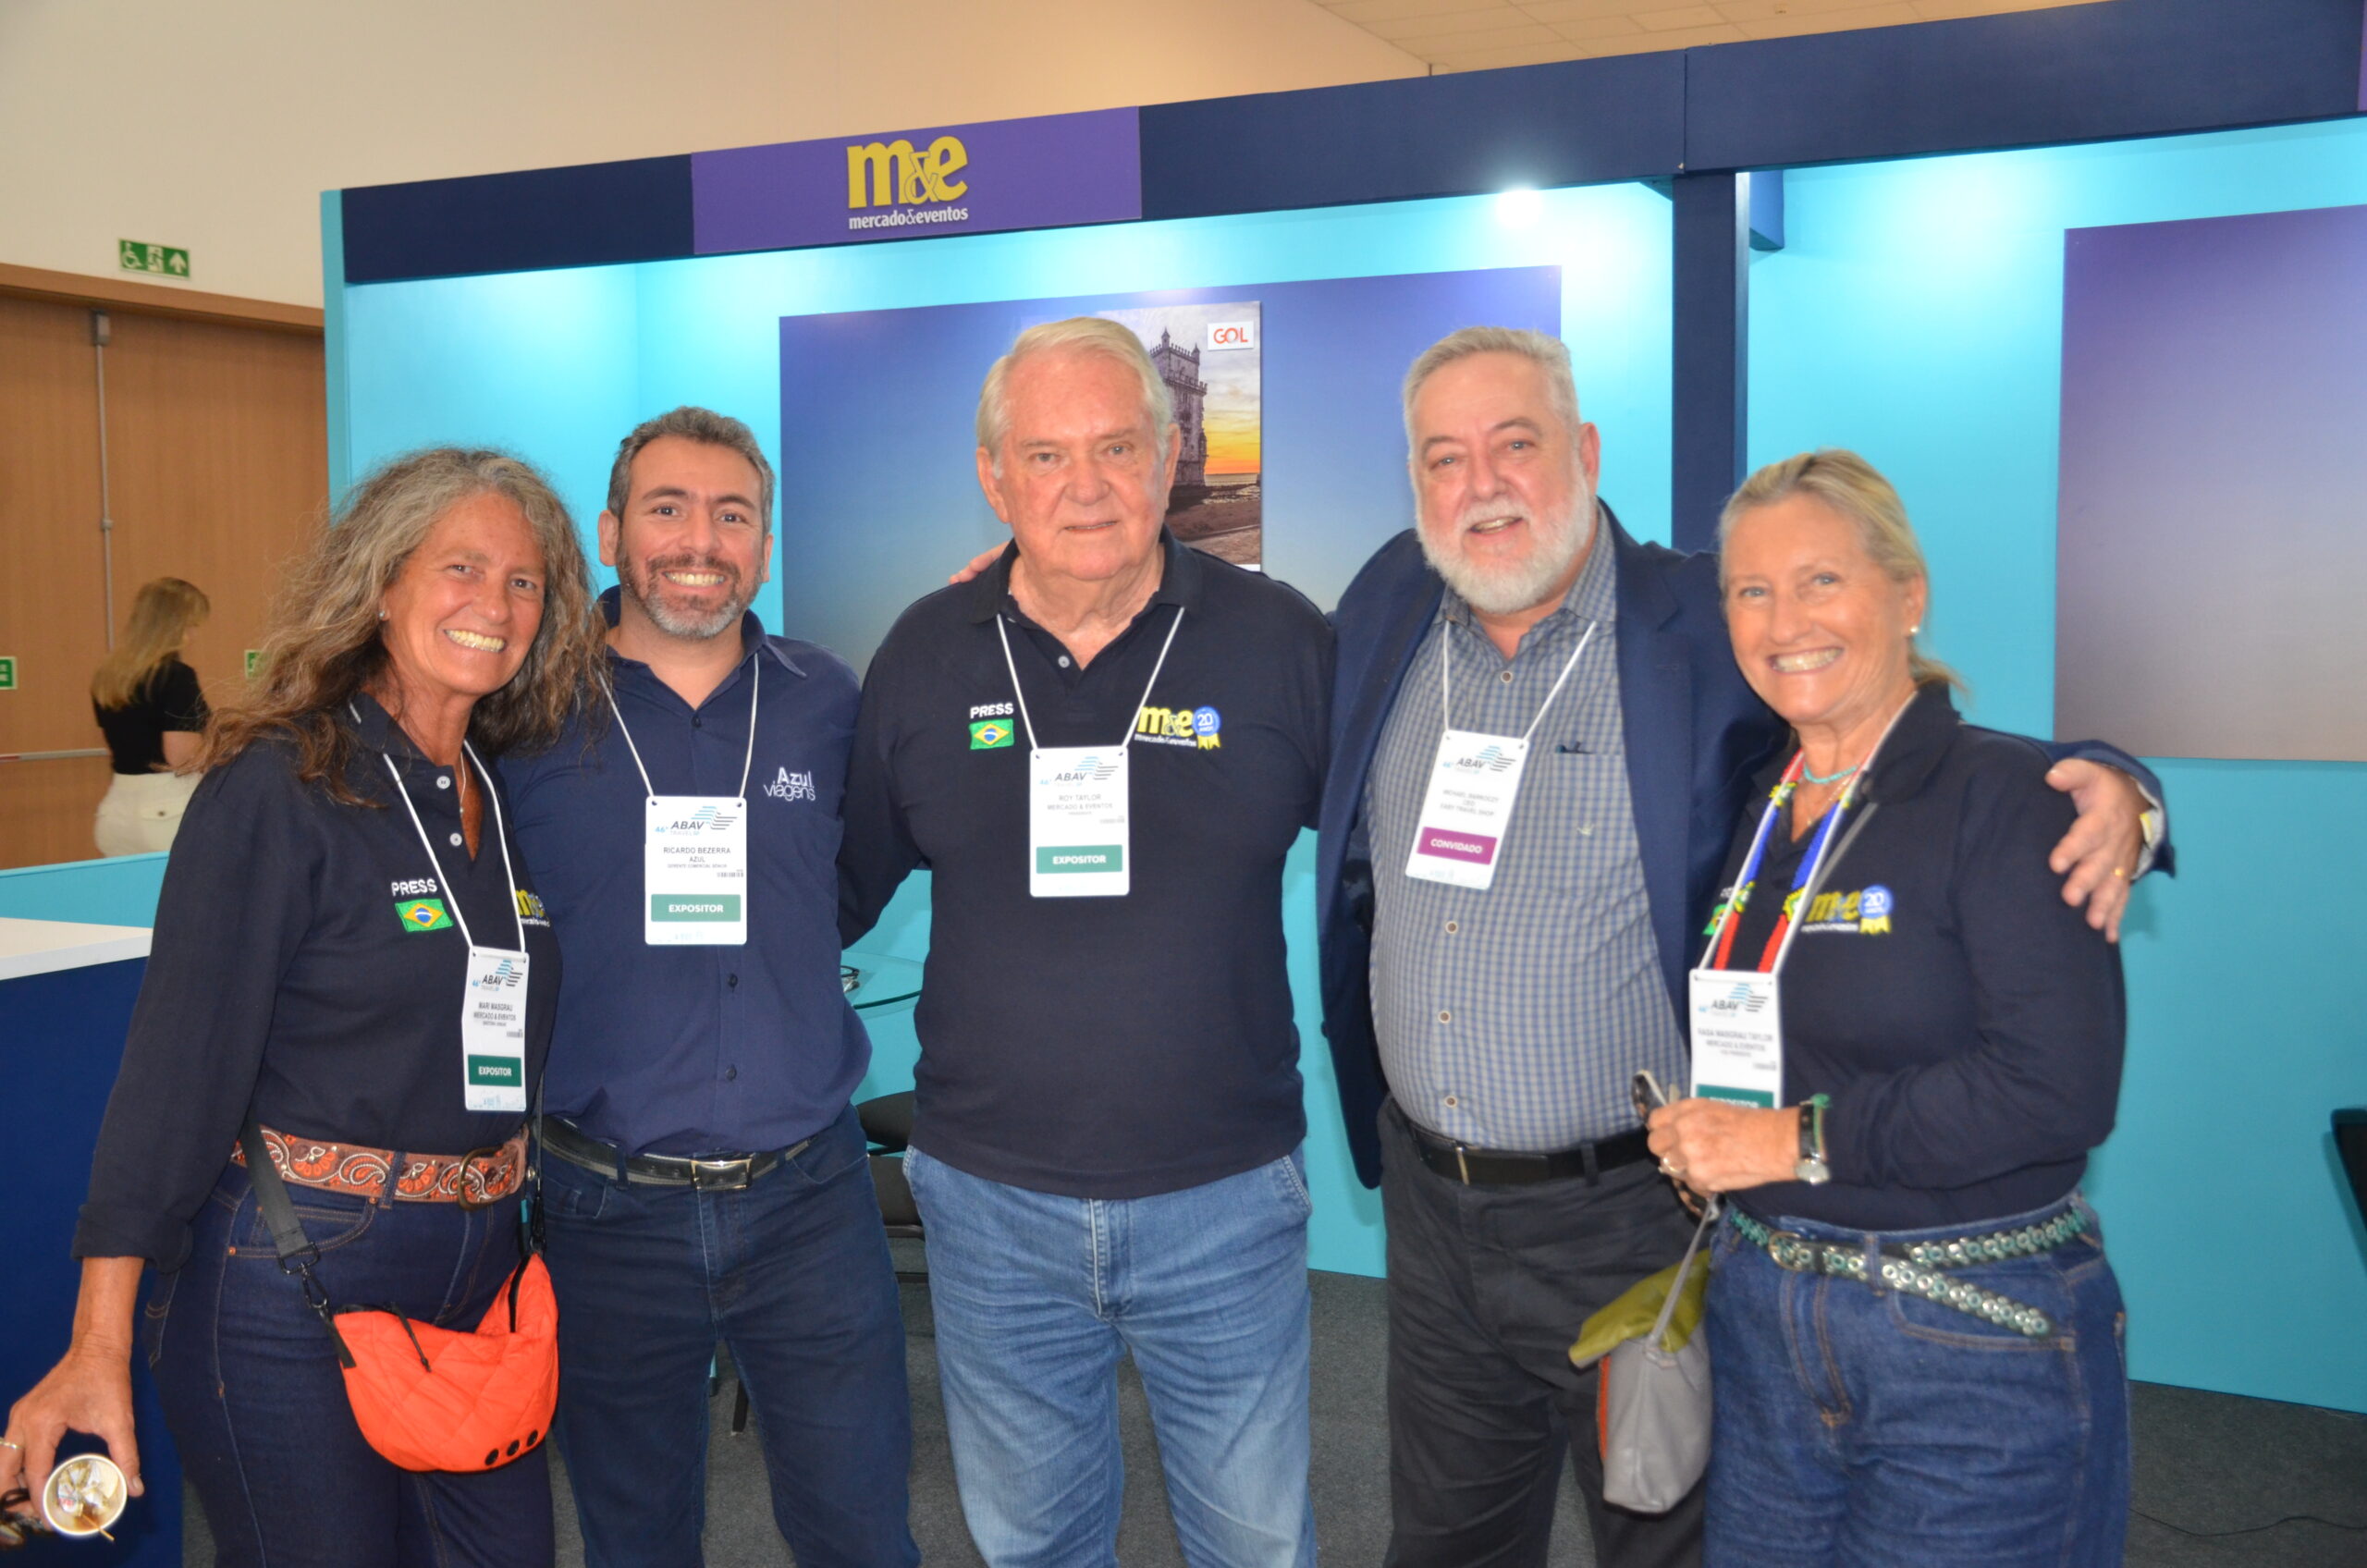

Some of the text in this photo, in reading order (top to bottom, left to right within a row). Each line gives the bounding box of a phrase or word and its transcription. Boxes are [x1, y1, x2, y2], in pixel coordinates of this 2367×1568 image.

[847, 136, 968, 209] m&e
[849, 206, 968, 229] mercado&eventos
[1213, 326, 1248, 344] GOL
[970, 703, 1013, 719] PRESS
[1136, 706, 1195, 738] m&e
[1197, 713, 1213, 727] 20
[1456, 757, 1487, 768] ABAV
[778, 766, 812, 788] Azul
[1054, 772, 1087, 781] ABAV
[763, 780, 816, 802] viagens
[670, 821, 705, 830] ABAV
[1430, 838, 1483, 854] CONVIDADO
[1052, 854, 1107, 865] EXPOSITOR
[391, 878, 437, 897] PRESS
[668, 904, 724, 913] EXPOSITOR
[482, 974, 503, 986] ABAV
[1711, 999, 1738, 1011] ABAV
[478, 1066, 512, 1077] EXPOSITOR
